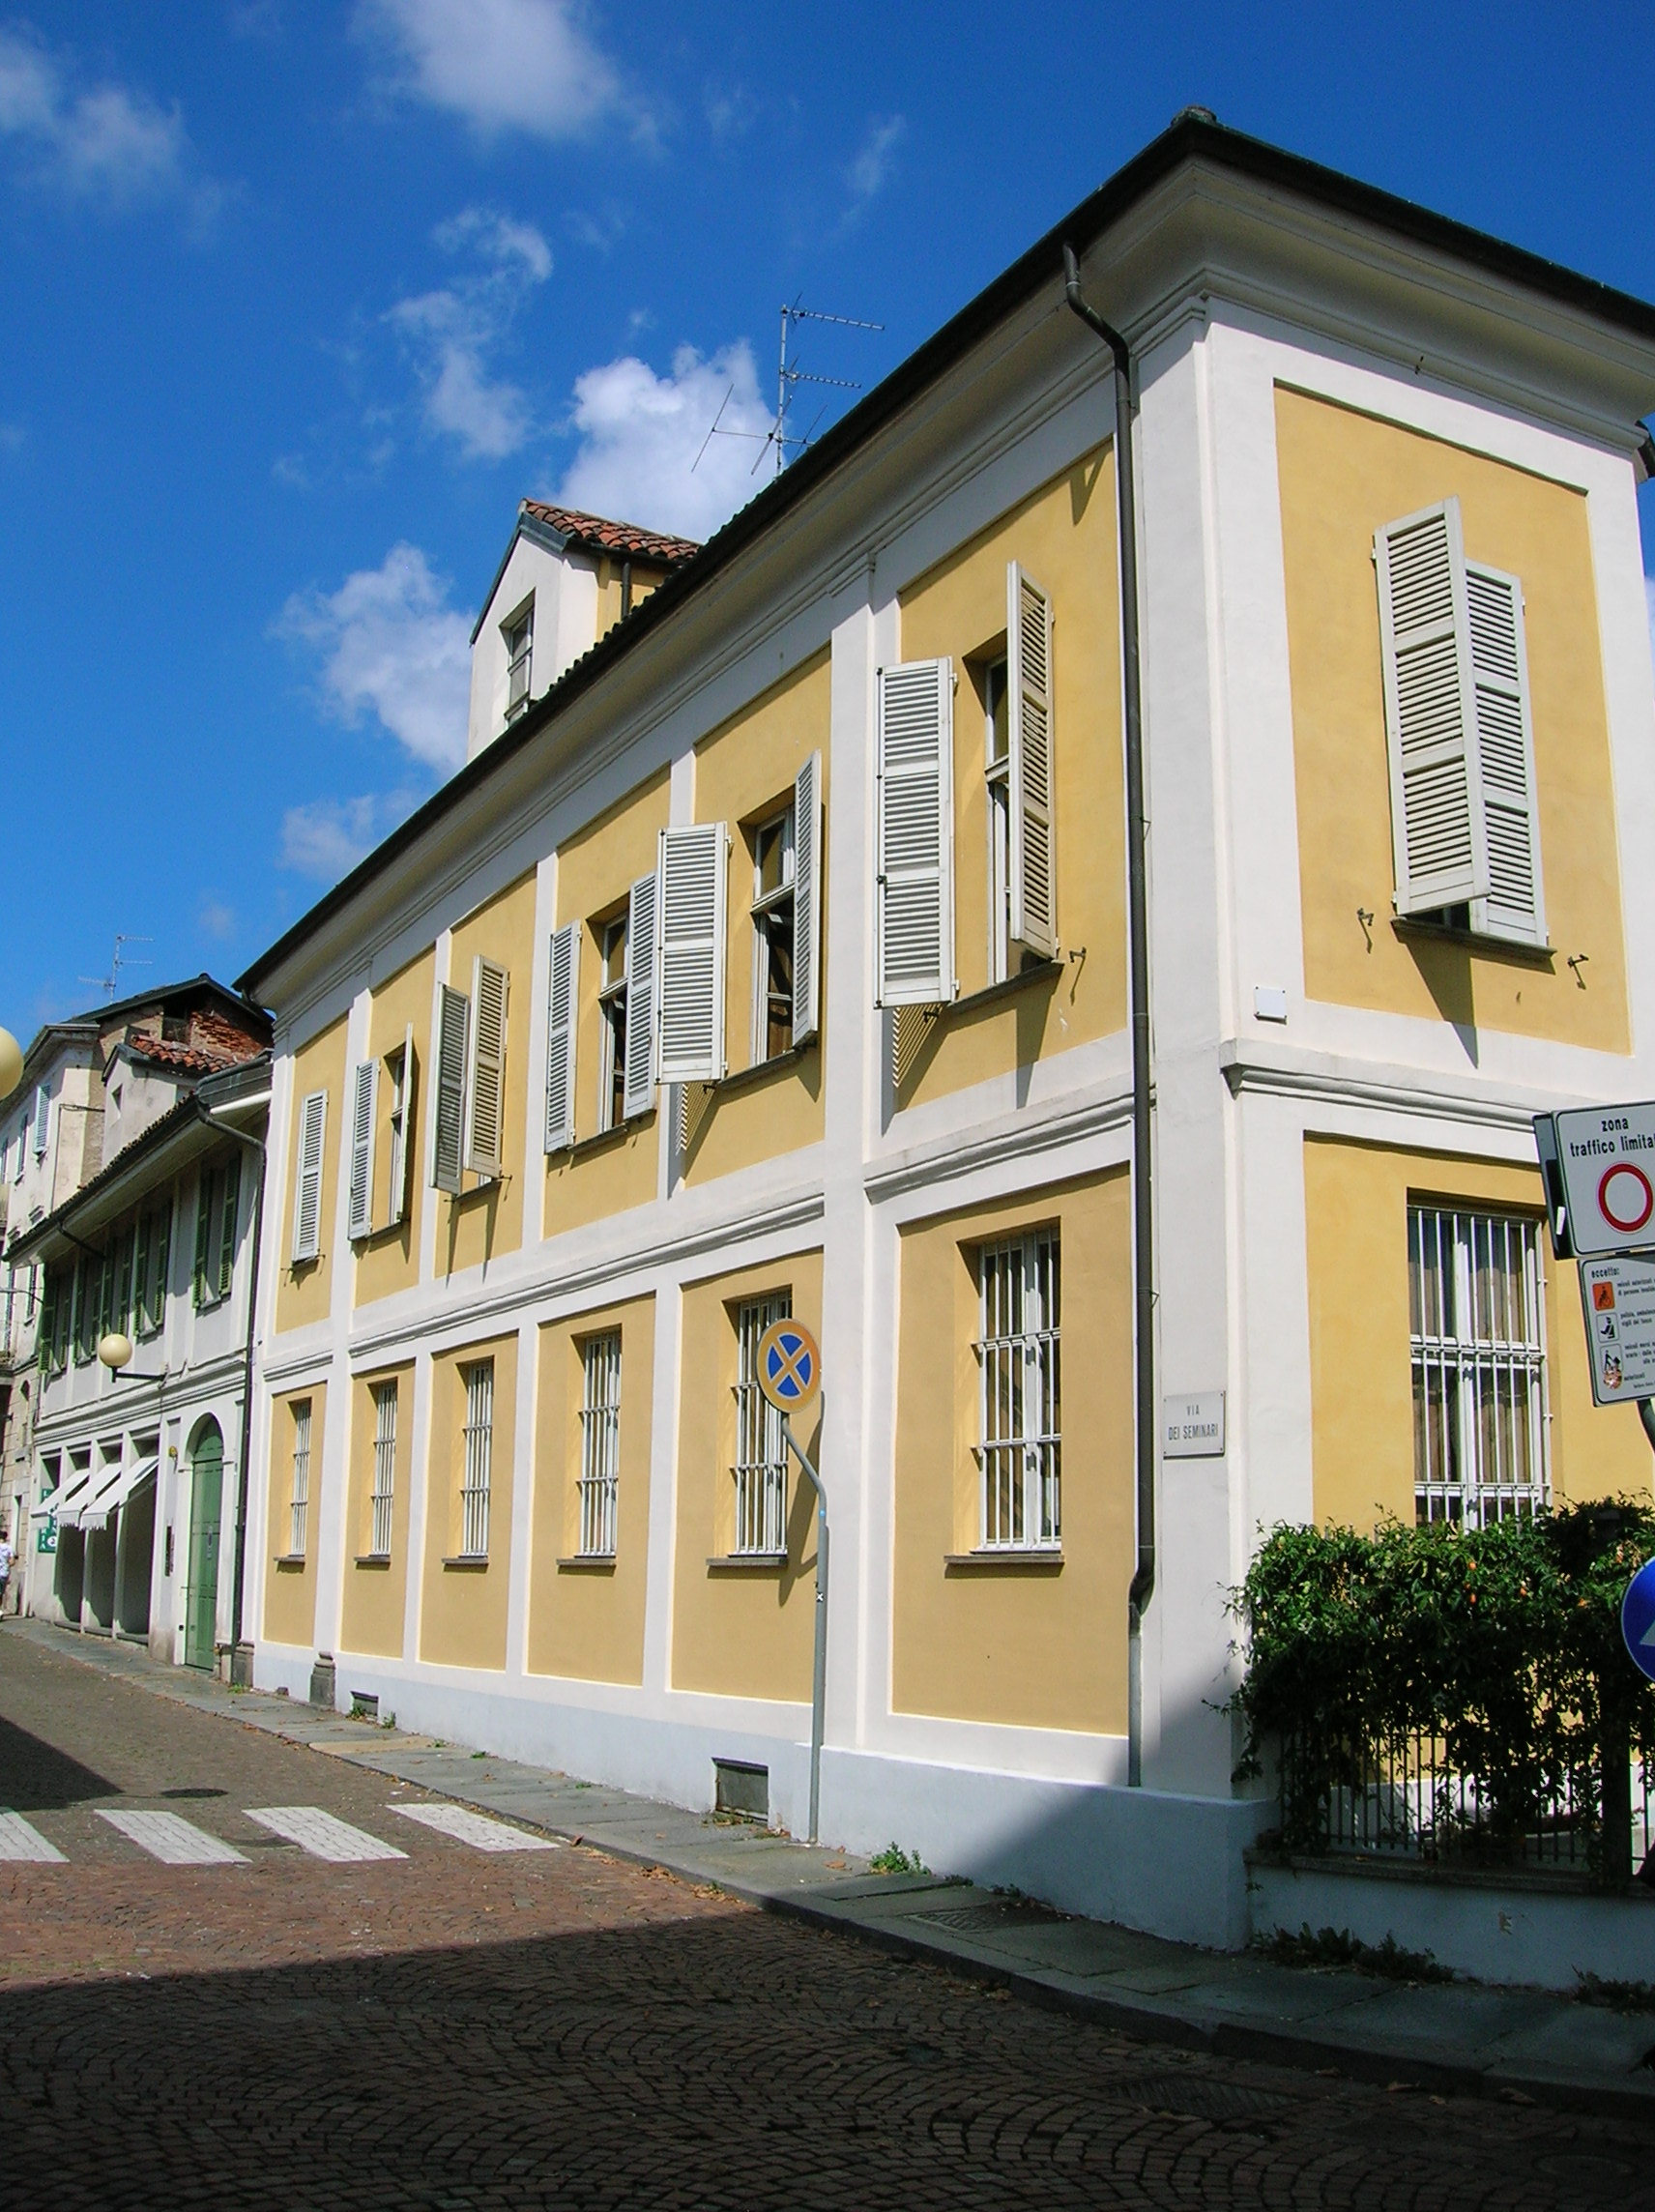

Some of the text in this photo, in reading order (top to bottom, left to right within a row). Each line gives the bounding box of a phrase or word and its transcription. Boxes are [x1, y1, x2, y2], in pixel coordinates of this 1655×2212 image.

[1601, 1118, 1629, 1132] zona
[1570, 1134, 1655, 1157] traffico limita
[1186, 1405, 1200, 1416] VIA
[1168, 1423, 1218, 1441] DEI SEMINARI
